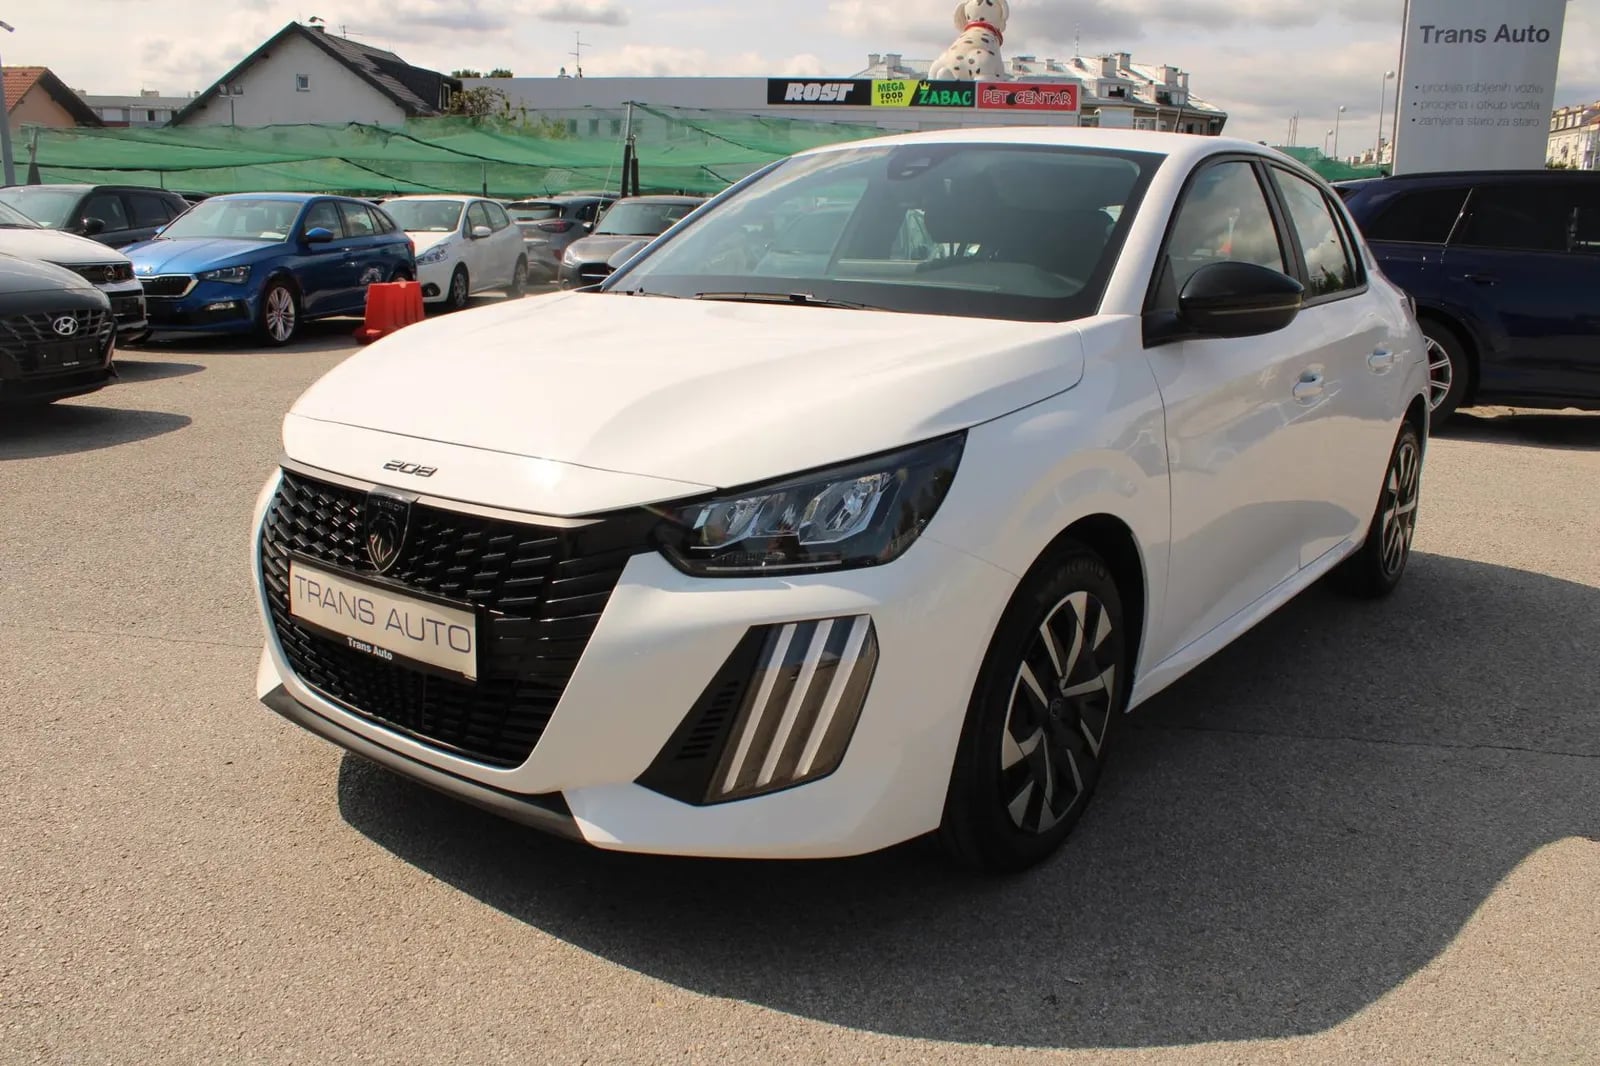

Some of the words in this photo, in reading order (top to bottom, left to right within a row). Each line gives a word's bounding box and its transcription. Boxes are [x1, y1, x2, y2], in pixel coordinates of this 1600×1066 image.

[1420, 24, 1487, 43] Trans
[1493, 23, 1551, 43] Auto
[878, 82, 905, 92] MEGA
[881, 92, 904, 100] FOOD
[982, 90, 1010, 104] PET
[1014, 91, 1072, 106] CENTAR
[383, 459, 438, 478] 208
[294, 574, 376, 626] TRANS
[385, 608, 472, 654] AUTO
[346, 637, 372, 654] Trans
[372, 645, 393, 661] Auto
